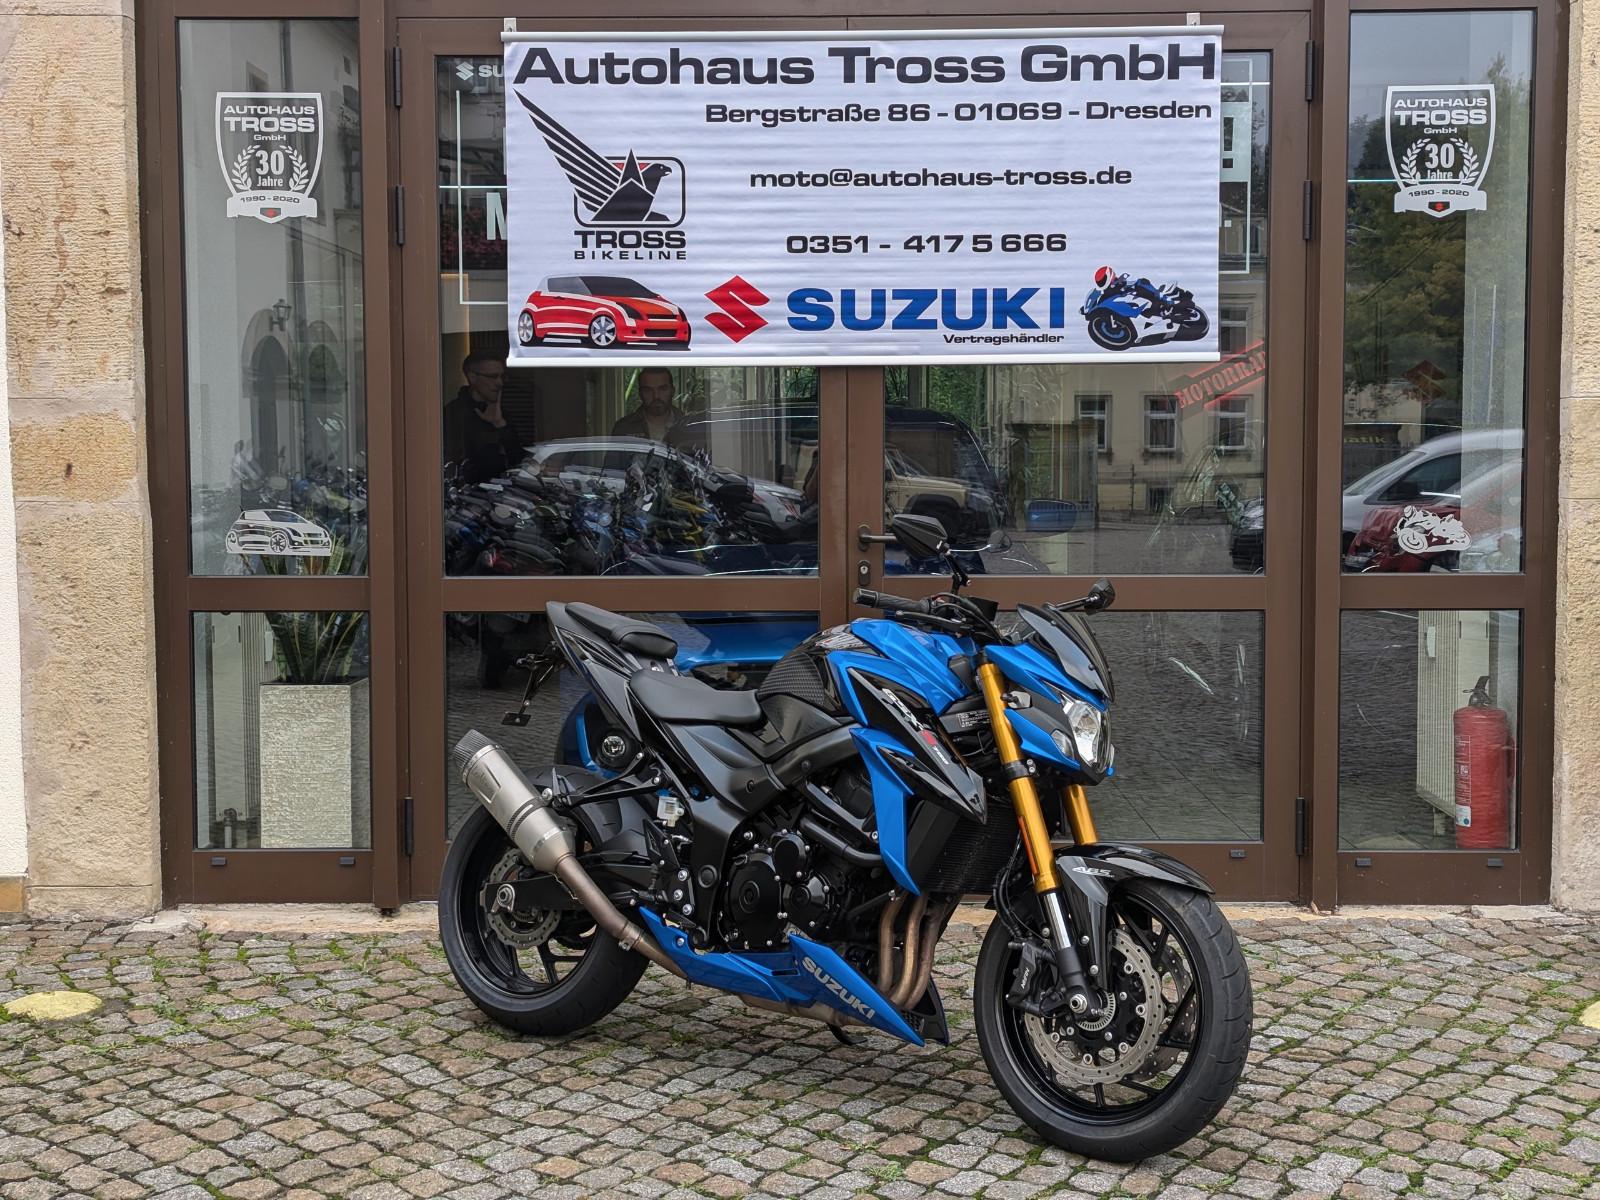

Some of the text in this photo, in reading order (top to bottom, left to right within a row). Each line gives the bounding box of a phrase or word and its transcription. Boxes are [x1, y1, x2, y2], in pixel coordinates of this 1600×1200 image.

[513, 42, 1216, 85] Autohaus Tross GmbH
[223, 105, 315, 115] AUTOHAUS
[1394, 97, 1488, 108] AUTOHAUS
[705, 103, 881, 128] Bergstraße
[887, 103, 931, 122] 86
[954, 101, 1062, 122] 01069
[1086, 100, 1212, 120] Dresden
[1394, 108, 1488, 126] TROSS
[223, 116, 315, 133] TROSS
[255, 149, 285, 175] 30
[1424, 143, 1455, 169] 30
[256, 176, 284, 187] Jahre
[750, 165, 1132, 188] moto@autohaus-tross.de
[1427, 169, 1454, 181] Jahre
[240, 195, 266, 203] 1990
[272, 195, 301, 204] 2020
[1408, 189, 1435, 197] 1990
[1441, 189, 1470, 197] 2020
[574, 230, 687, 249] TROSS
[786, 235, 869, 254] 0351
[903, 234, 964, 254] 417
[1000, 233, 1067, 253] 666
[574, 250, 687, 261] BIKELINE
[786, 287, 1065, 332] SUZUKI
[943, 332, 1065, 346] Vertragshändler
[802, 956, 876, 1020] SUZUKI
